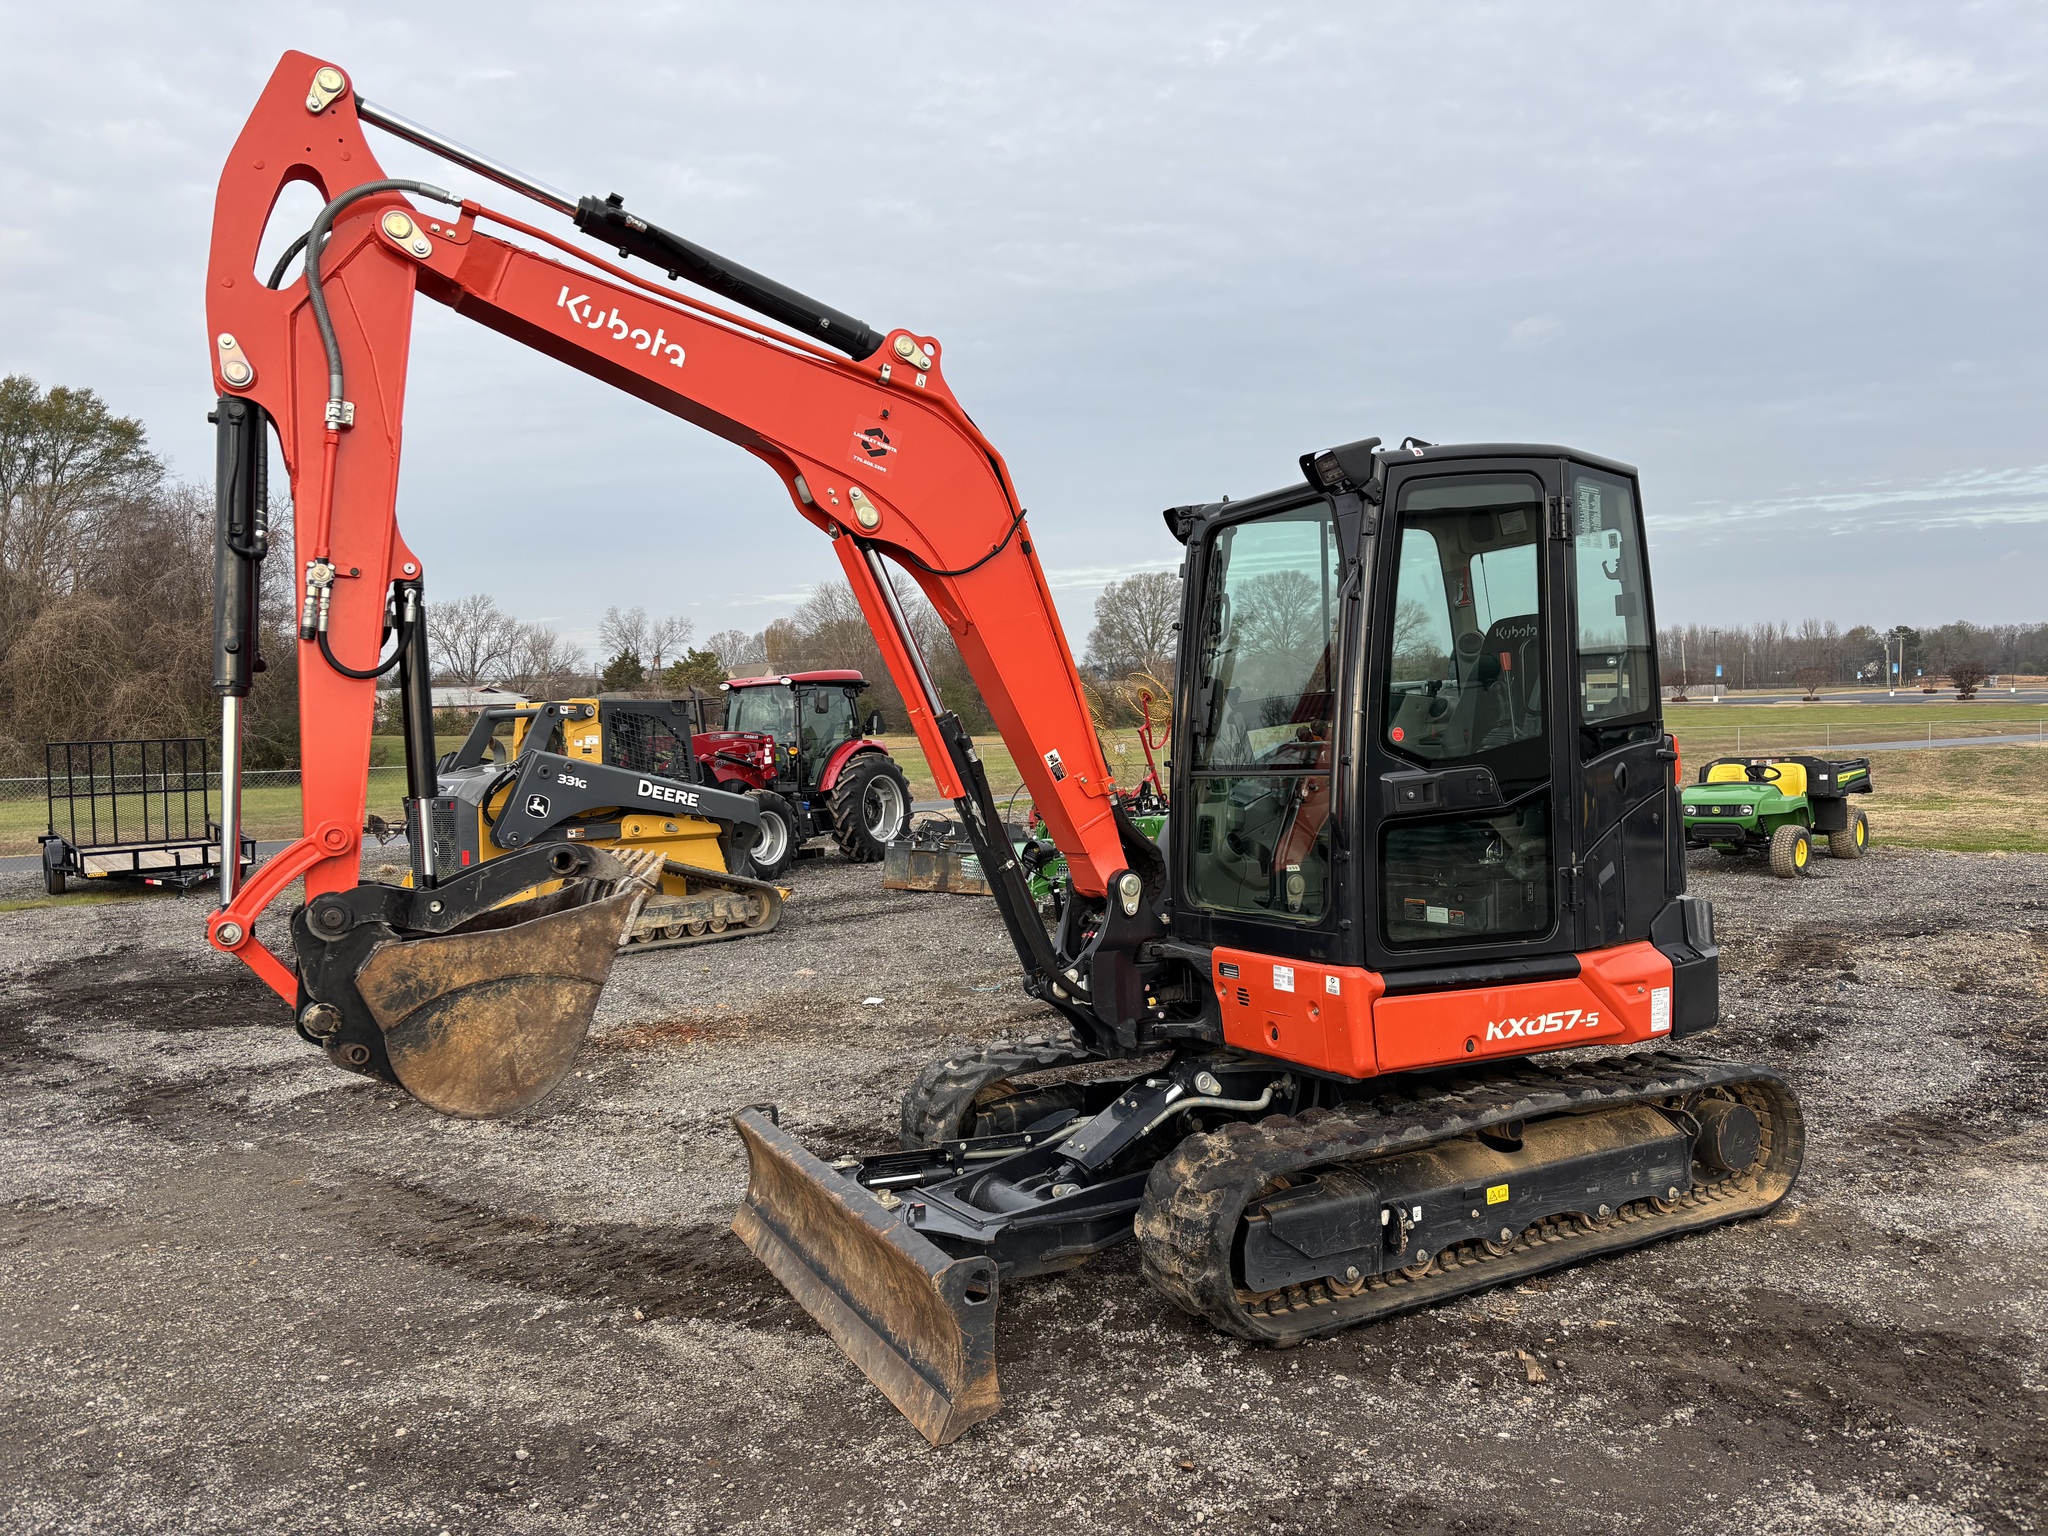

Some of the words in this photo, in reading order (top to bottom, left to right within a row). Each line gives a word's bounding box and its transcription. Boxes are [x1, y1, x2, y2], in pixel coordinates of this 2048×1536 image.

[557, 285, 686, 368] Kubota
[877, 441, 898, 453] KUBOTA
[1495, 623, 1538, 640] Kubota
[557, 774, 588, 789] 331G
[637, 779, 700, 808] DEERE
[1485, 1009, 1600, 1041] KX057-5
